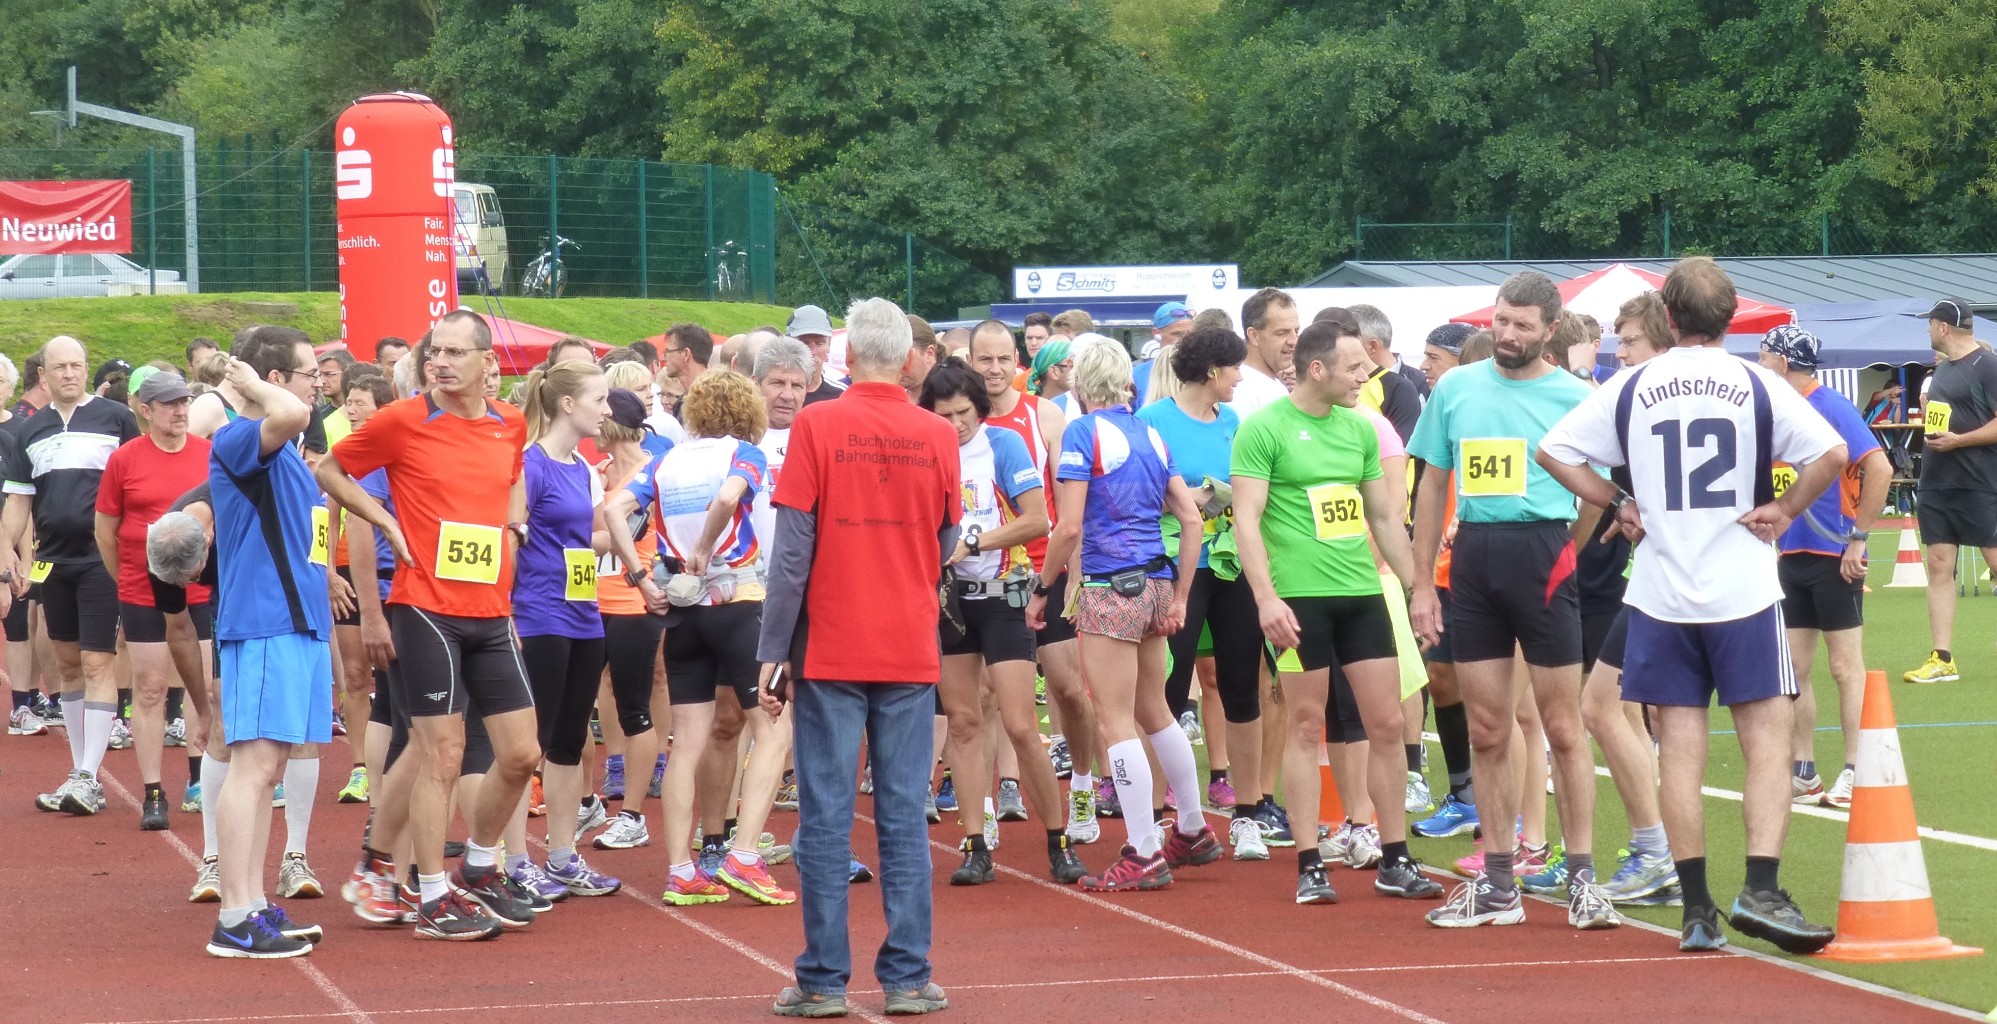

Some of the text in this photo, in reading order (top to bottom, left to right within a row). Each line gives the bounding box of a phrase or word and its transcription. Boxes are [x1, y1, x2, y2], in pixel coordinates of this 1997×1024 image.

[2, 216, 116, 242] Neuwied
[424, 217, 445, 229] Fair.
[425, 250, 448, 262] Nah.
[1056, 272, 1116, 292] Schmitz
[1638, 376, 1750, 410] Lindscheid
[1927, 411, 1946, 427] 507
[848, 433, 927, 451] Buchholzer
[835, 449, 940, 468] Bahndammlauf
[1469, 454, 1512, 480] 541
[1650, 417, 1737, 512] 12
[1320, 498, 1359, 524] 552
[447, 539, 493, 567] 534
